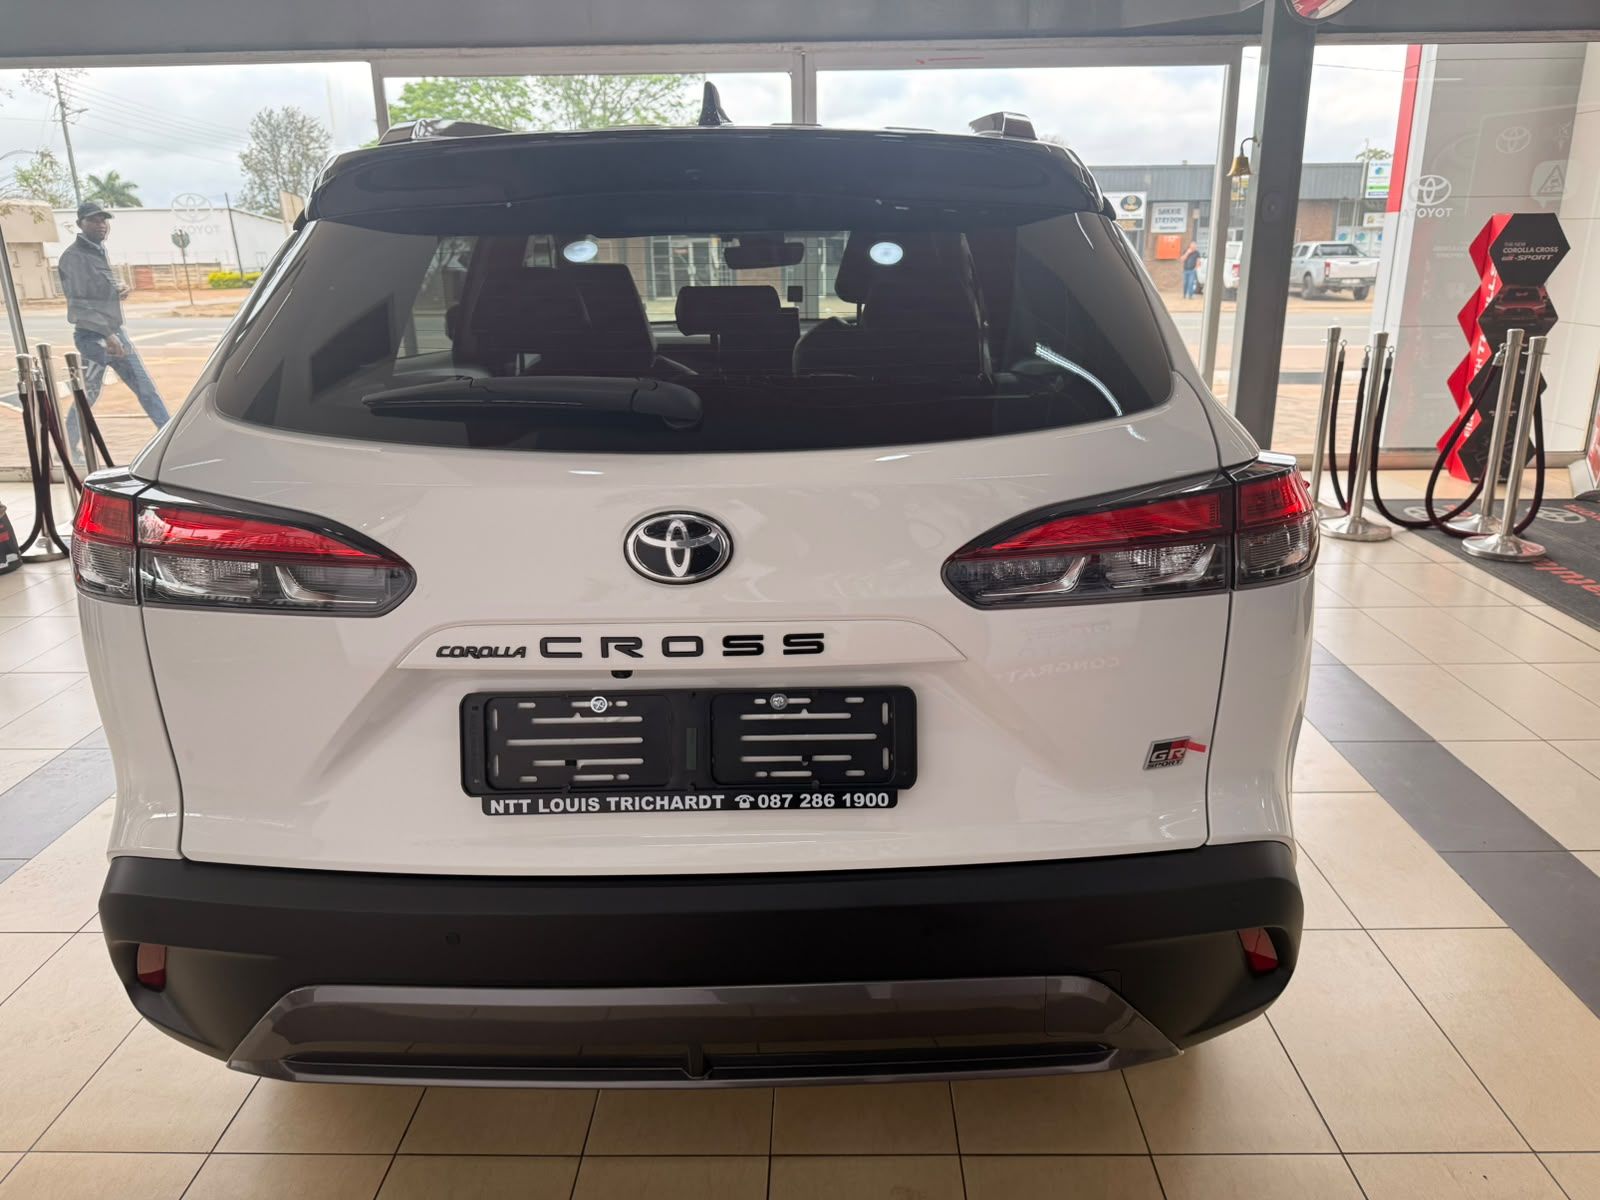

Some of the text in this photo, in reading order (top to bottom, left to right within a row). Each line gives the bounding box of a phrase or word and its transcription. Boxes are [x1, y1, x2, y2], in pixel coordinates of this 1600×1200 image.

[436, 633, 825, 659] COROLLA CROSS
[1150, 747, 1187, 761] GR
[1147, 760, 1184, 769] SPORT
[490, 792, 889, 814] NTT LOUIS TRICHARDT 087 286 1900
